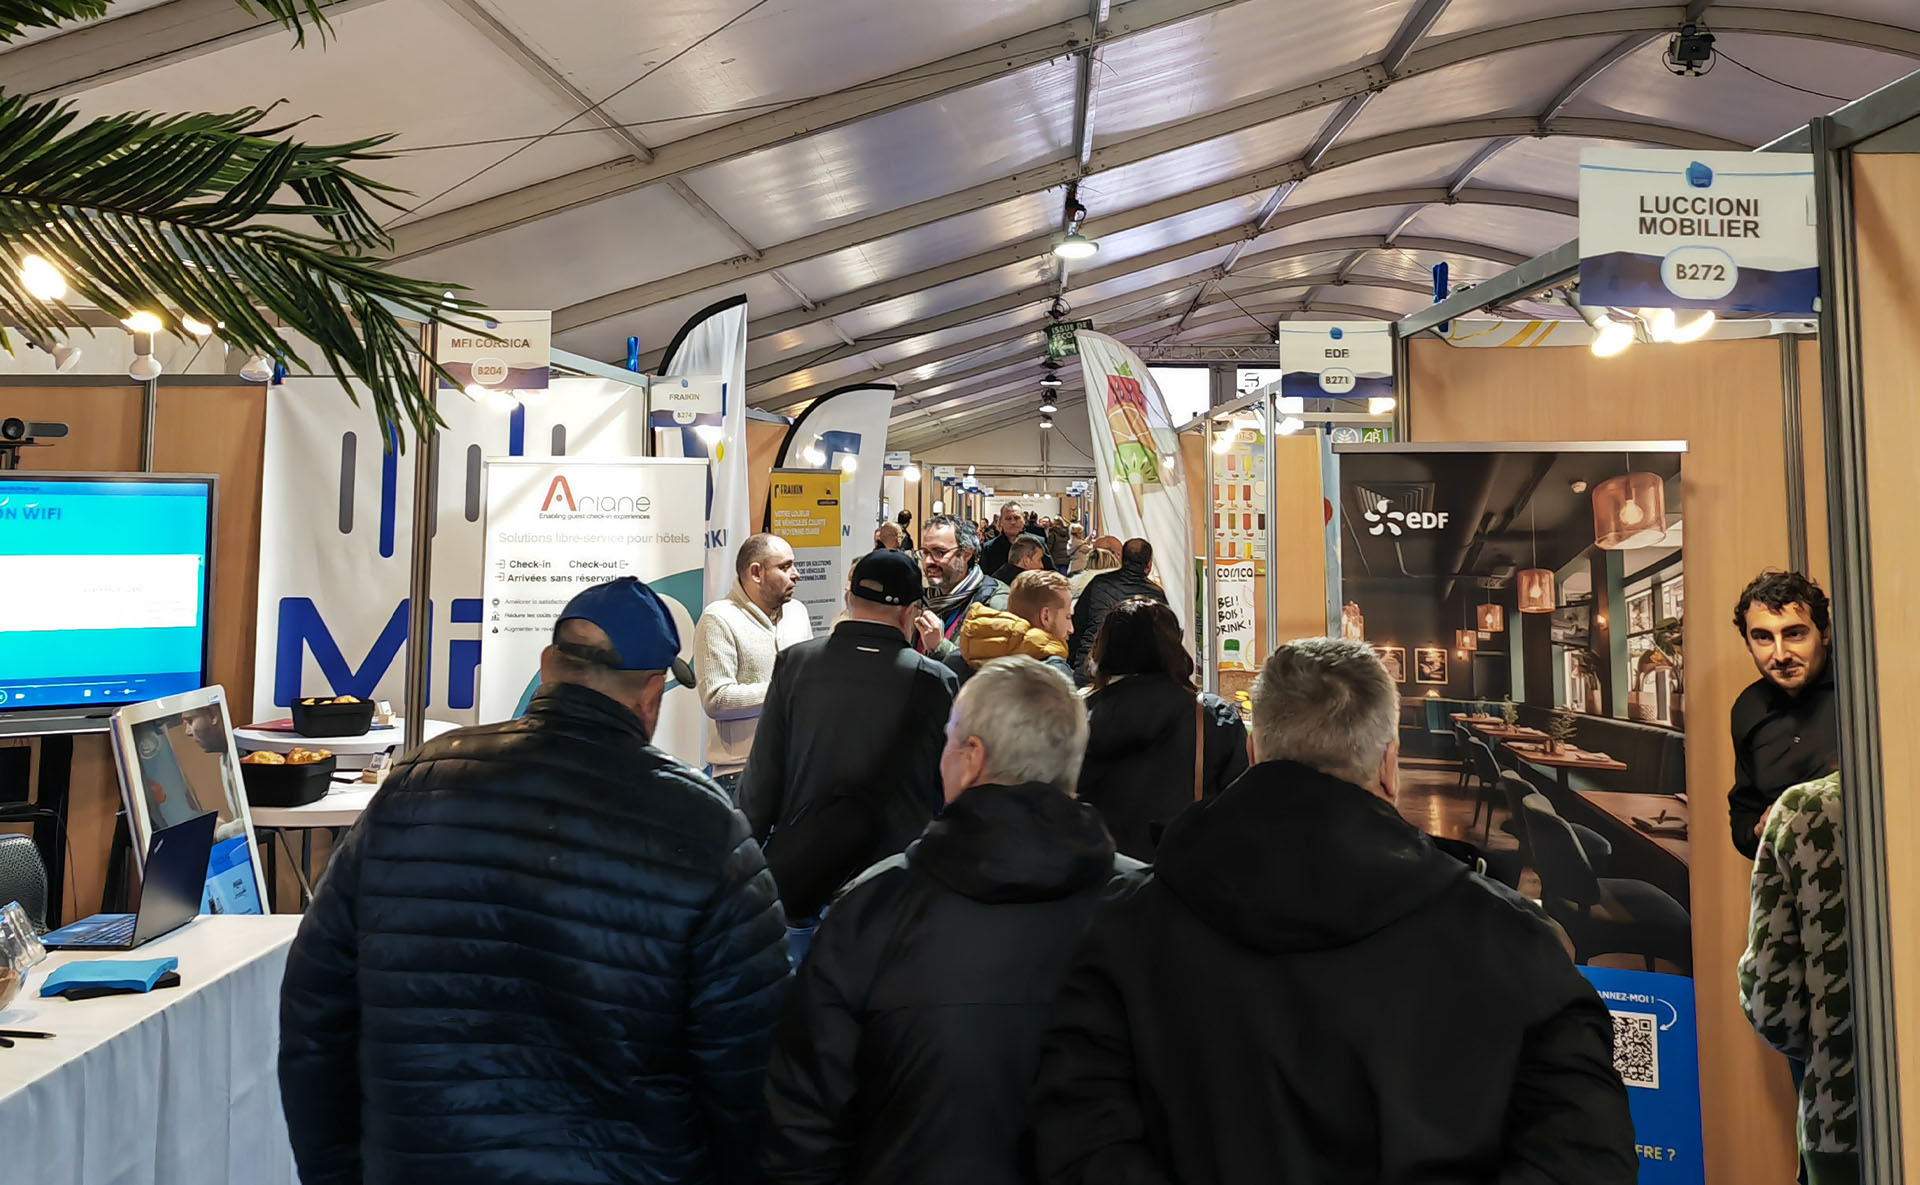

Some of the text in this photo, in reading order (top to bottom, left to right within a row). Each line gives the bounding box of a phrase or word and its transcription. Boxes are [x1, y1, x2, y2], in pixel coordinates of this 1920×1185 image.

[1639, 196, 1759, 217] LUCCIONI
[1639, 217, 1760, 238] MOBILIER
[1676, 263, 1725, 281] B272
[1051, 324, 1075, 333] ISSUE
[1052, 332, 1073, 340] SECO
[451, 338, 530, 348] MFI CORSICA
[1325, 349, 1349, 358] EDF
[478, 366, 502, 375] B204
[1325, 376, 1349, 384] B271
[669, 393, 700, 401] FRAIKIN
[541, 475, 651, 512] Ariane
[22, 507, 62, 520] WIFI
[499, 532, 690, 545] Solutions libre-service pour hôtels
[509, 560, 618, 568] Check-in Check-out
[507, 574, 547, 582] Arrivées
[575, 574, 617, 582] réservati
[1635, 1144, 1662, 1160] FRE
